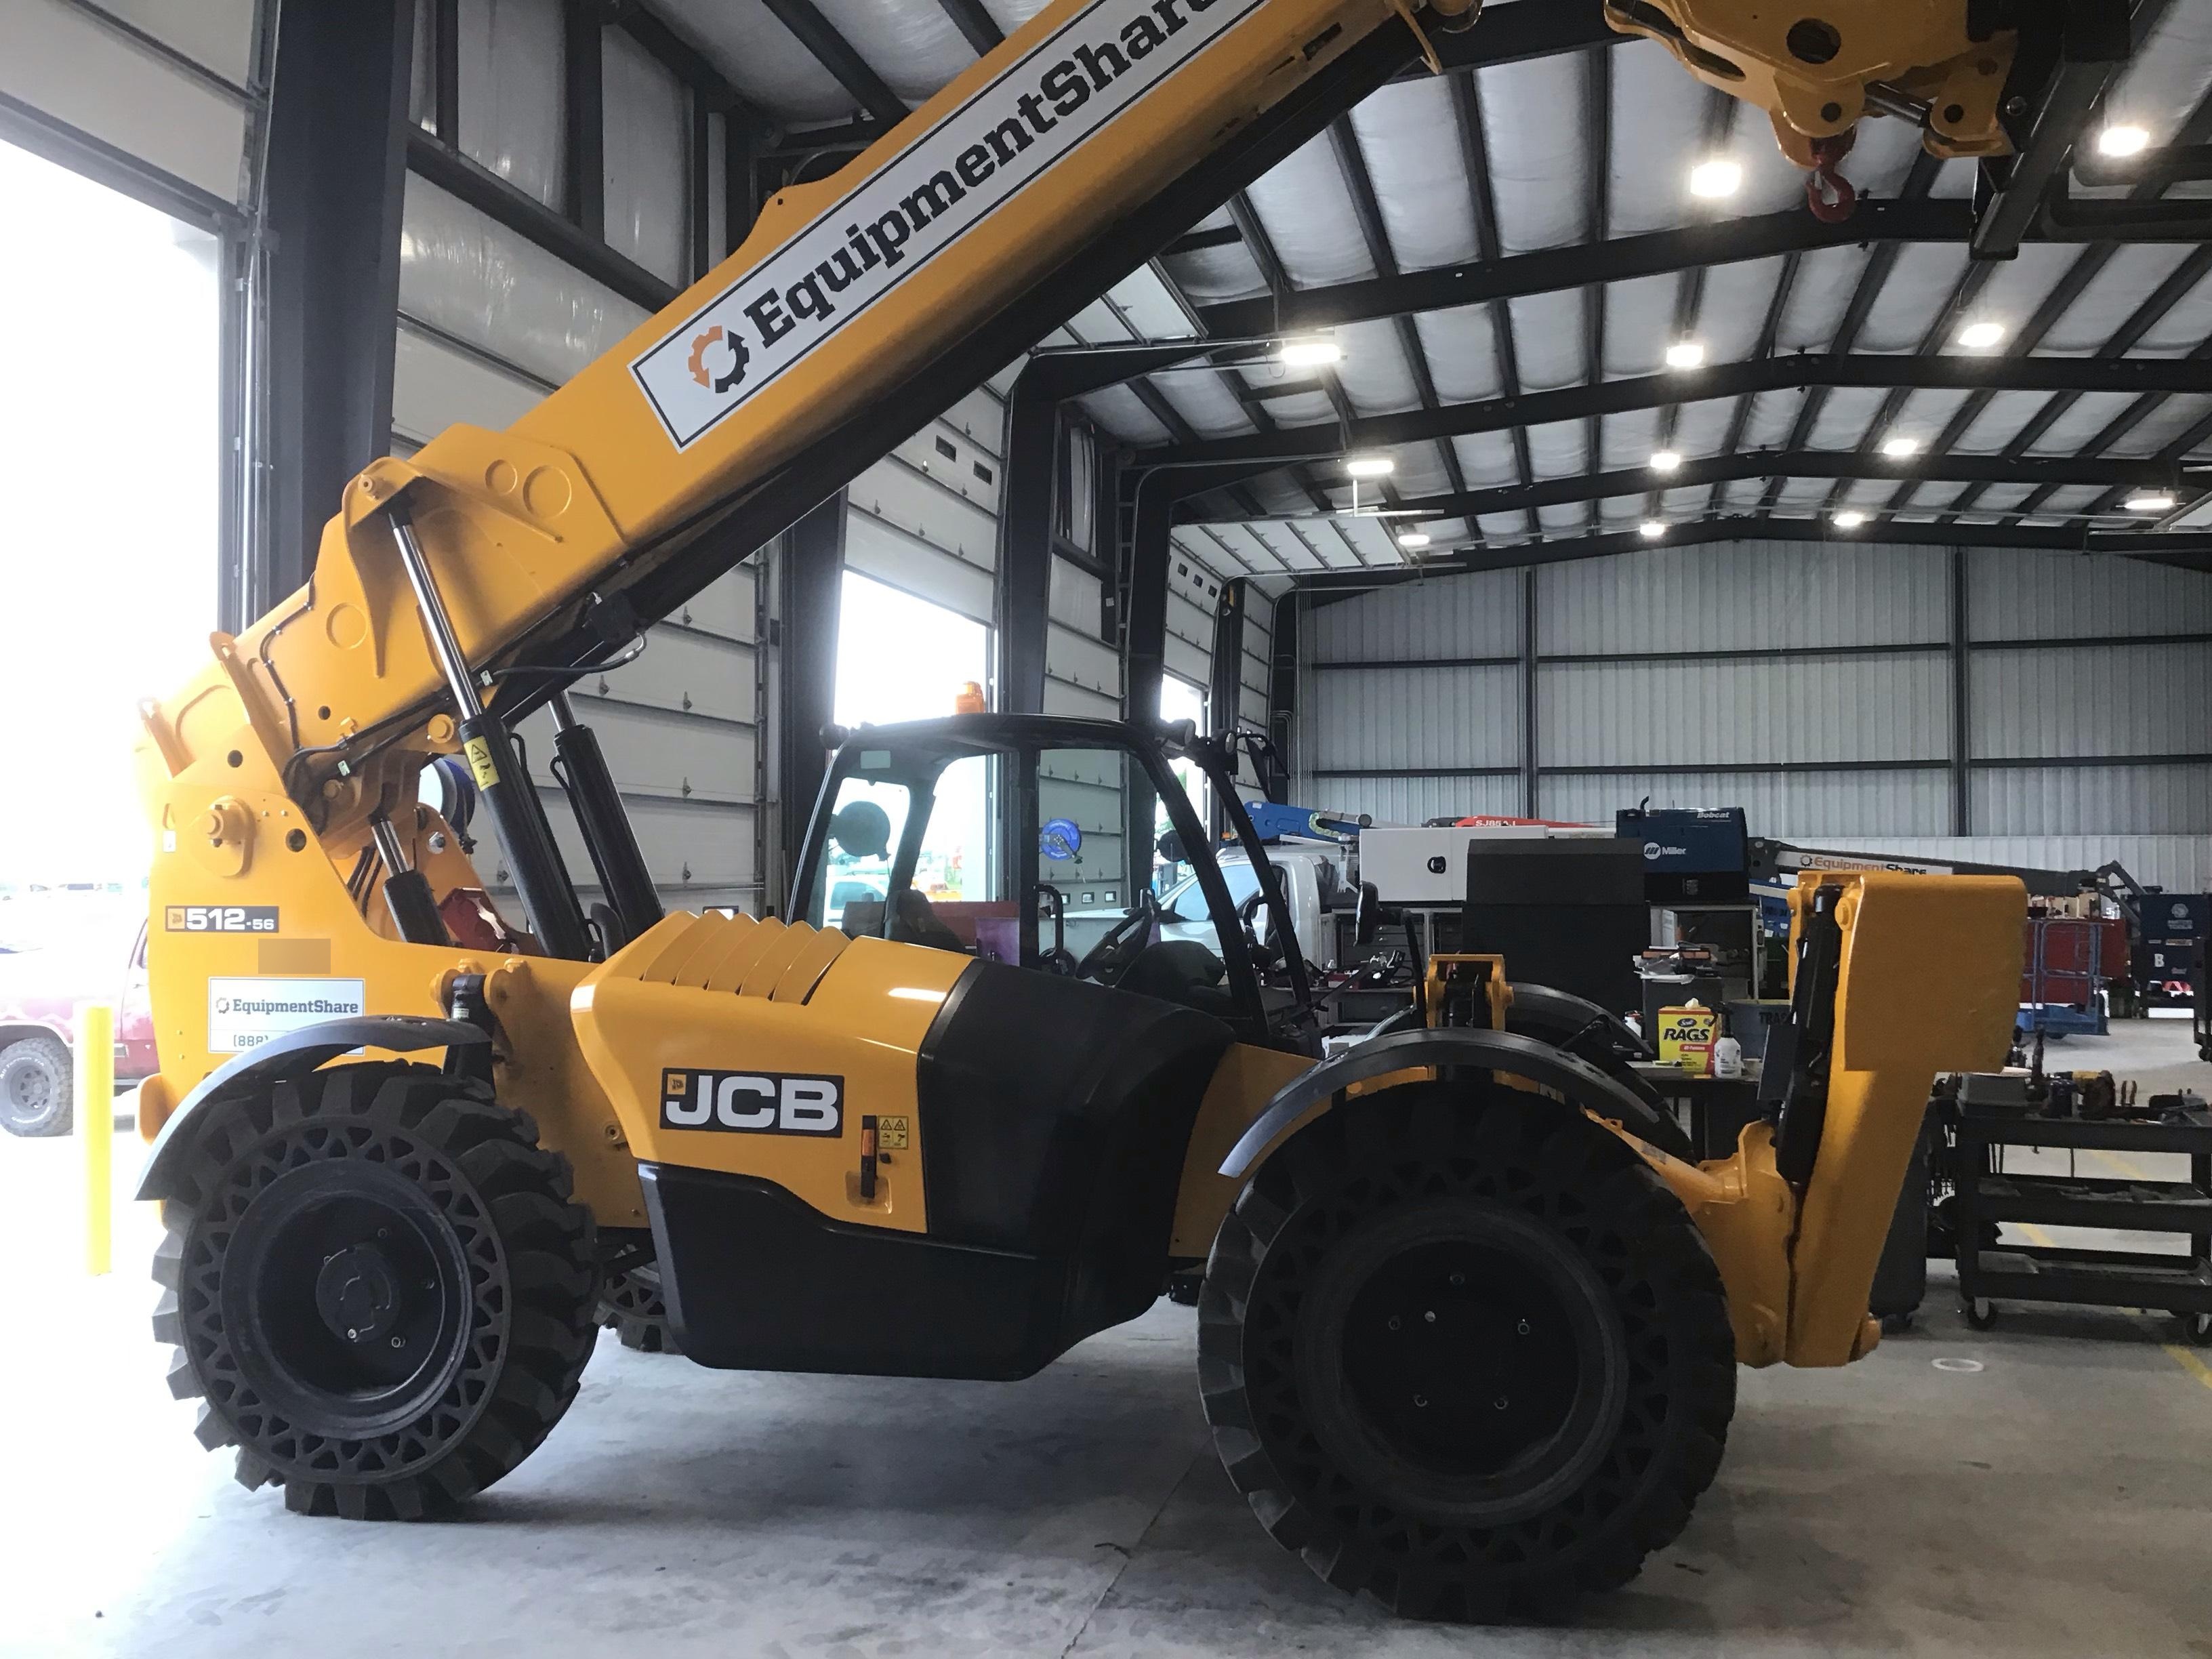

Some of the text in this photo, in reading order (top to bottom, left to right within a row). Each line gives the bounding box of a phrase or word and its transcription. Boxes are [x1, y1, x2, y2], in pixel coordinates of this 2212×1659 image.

[743, 0, 1218, 349] EquipmentShar
[1662, 846, 1687, 855] Miller
[186, 907, 274, 930] 512-56
[232, 998, 359, 1015] EquipmentShare
[1663, 1028, 1710, 1042] RAGS
[665, 1075, 839, 1131] JCB
